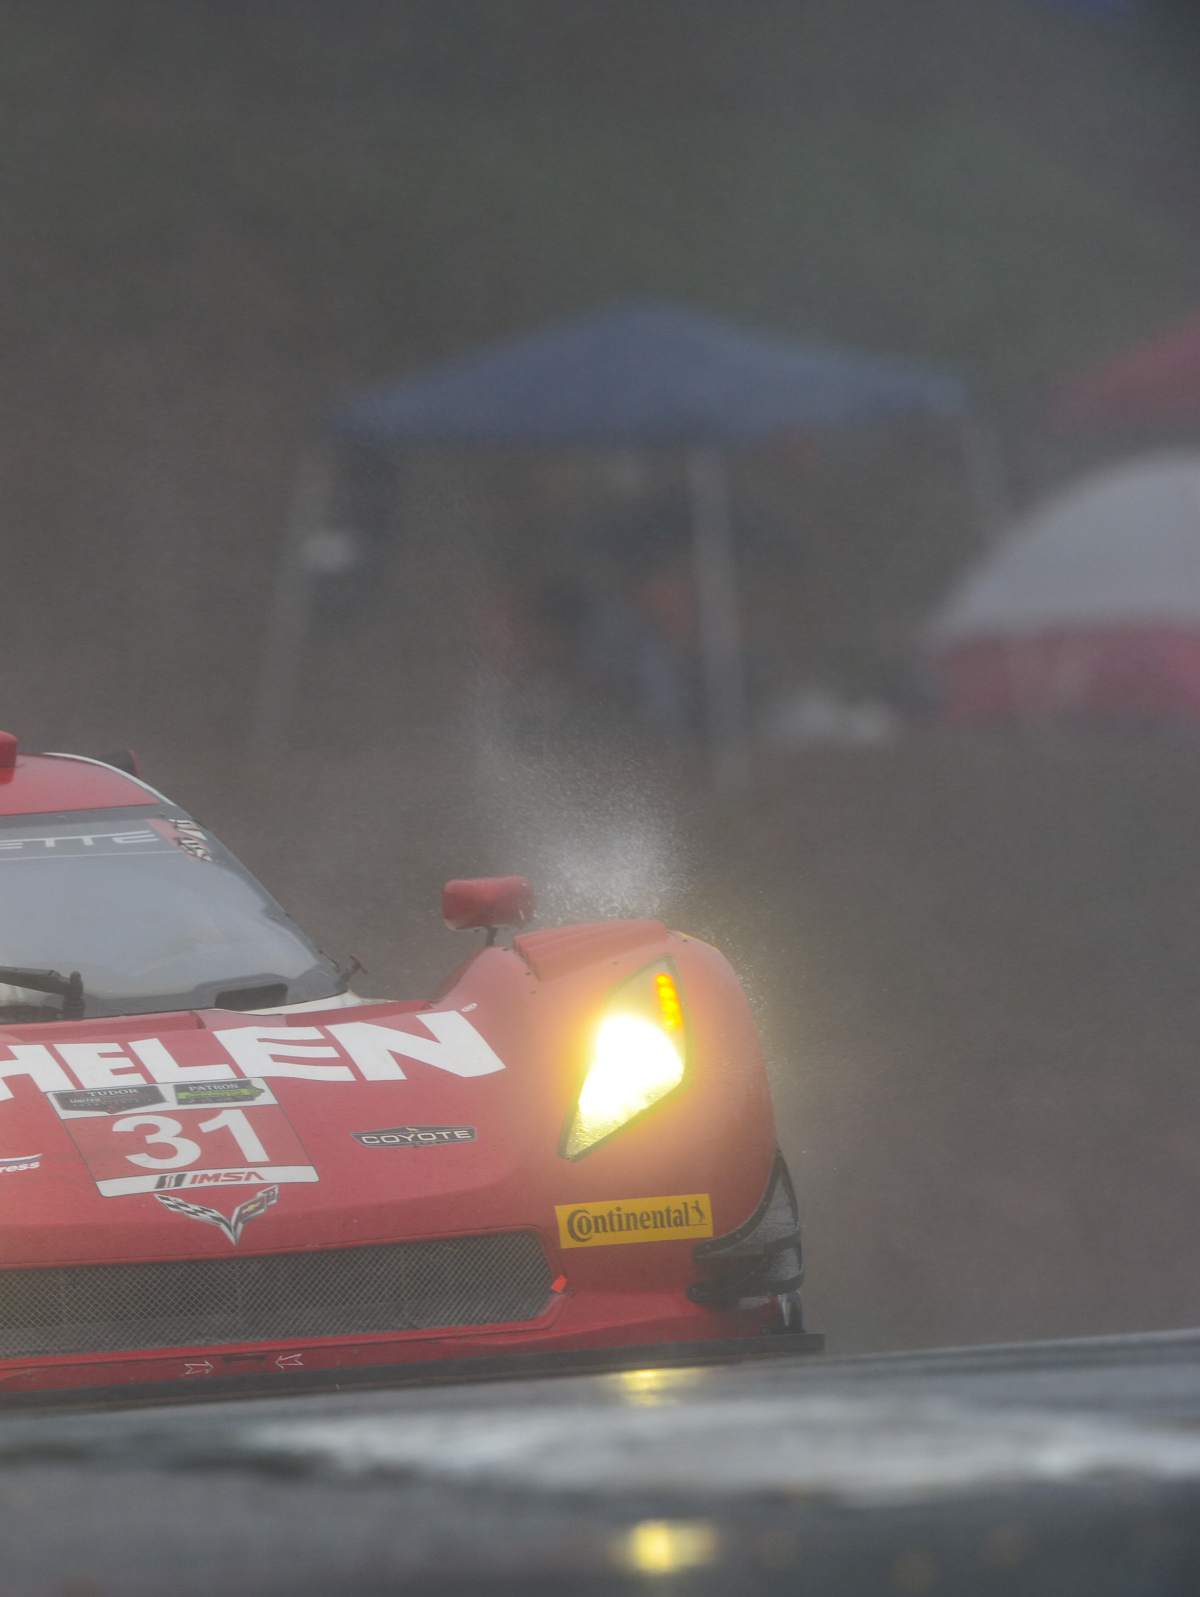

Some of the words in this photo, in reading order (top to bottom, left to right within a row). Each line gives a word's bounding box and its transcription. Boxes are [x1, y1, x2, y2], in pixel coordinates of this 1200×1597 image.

[87, 1088, 139, 1097] TUDOR
[111, 1109, 270, 1169] 31
[361, 1130, 472, 1144] COYOTE
[189, 1171, 265, 1184] IMSA
[567, 1201, 689, 1242] Continental
